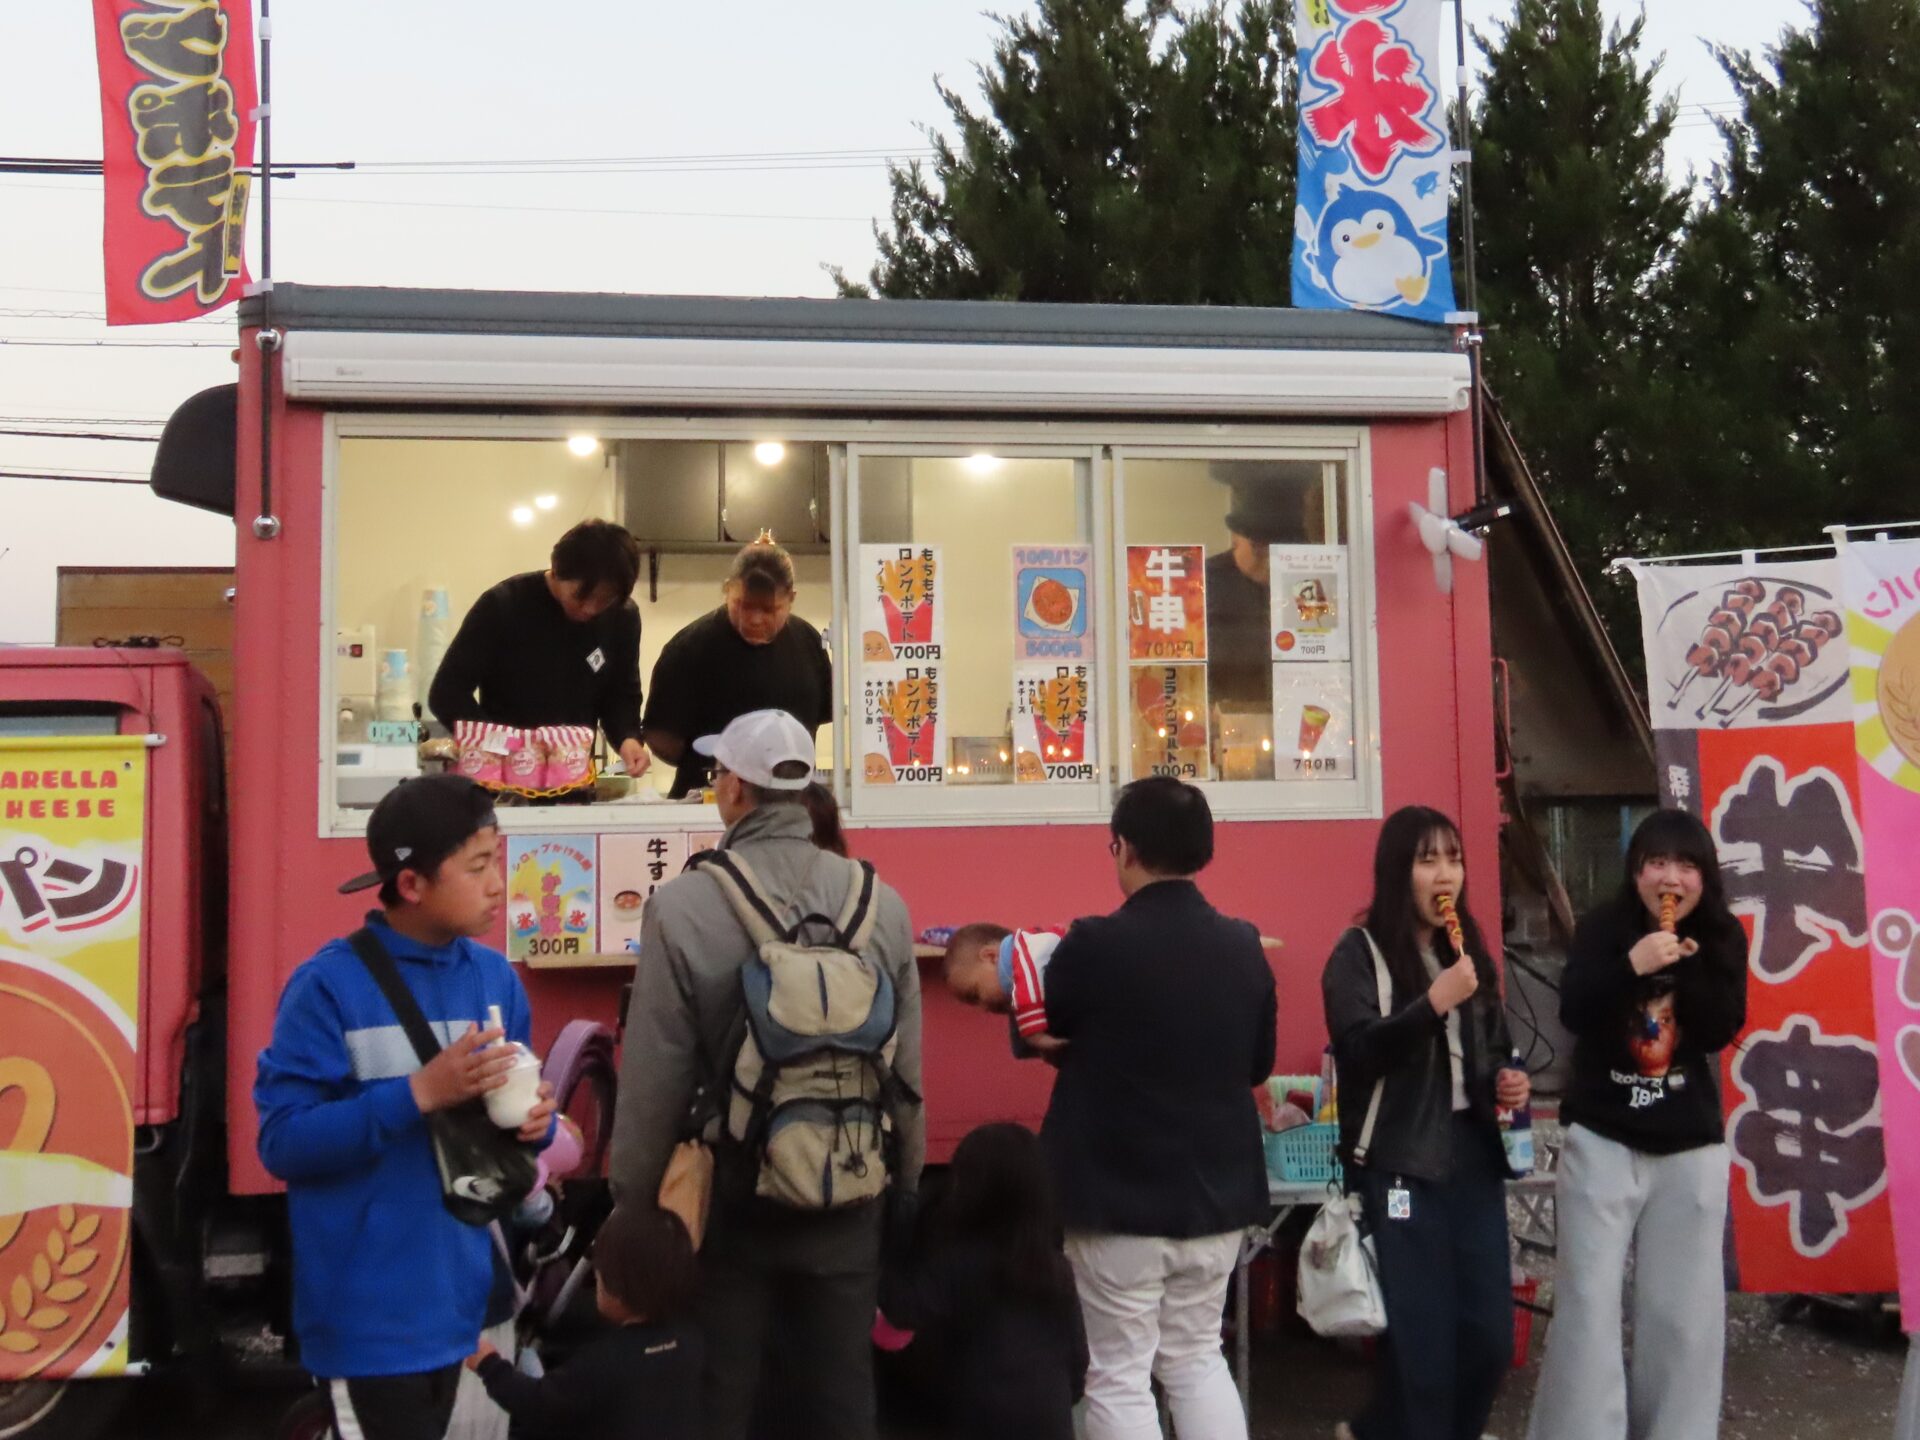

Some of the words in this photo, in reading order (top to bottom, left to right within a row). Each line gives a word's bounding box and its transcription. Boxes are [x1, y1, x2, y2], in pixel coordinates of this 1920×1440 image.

[921, 548, 934, 606] もちもち
[899, 548, 914, 641] ロングポテト
[1145, 548, 1186, 635] 牛串
[894, 645, 941, 660] 700円
[1300, 645, 1326, 655] 700円
[925, 666, 938, 724] もちもち
[906, 667, 920, 762] ロングポテト
[0, 770, 118, 789] ARELLA
[896, 767, 942, 782] 700円
[1047, 764, 1093, 780] 700円
[6, 799, 116, 818] HEESE
[529, 937, 579, 955] 300円
